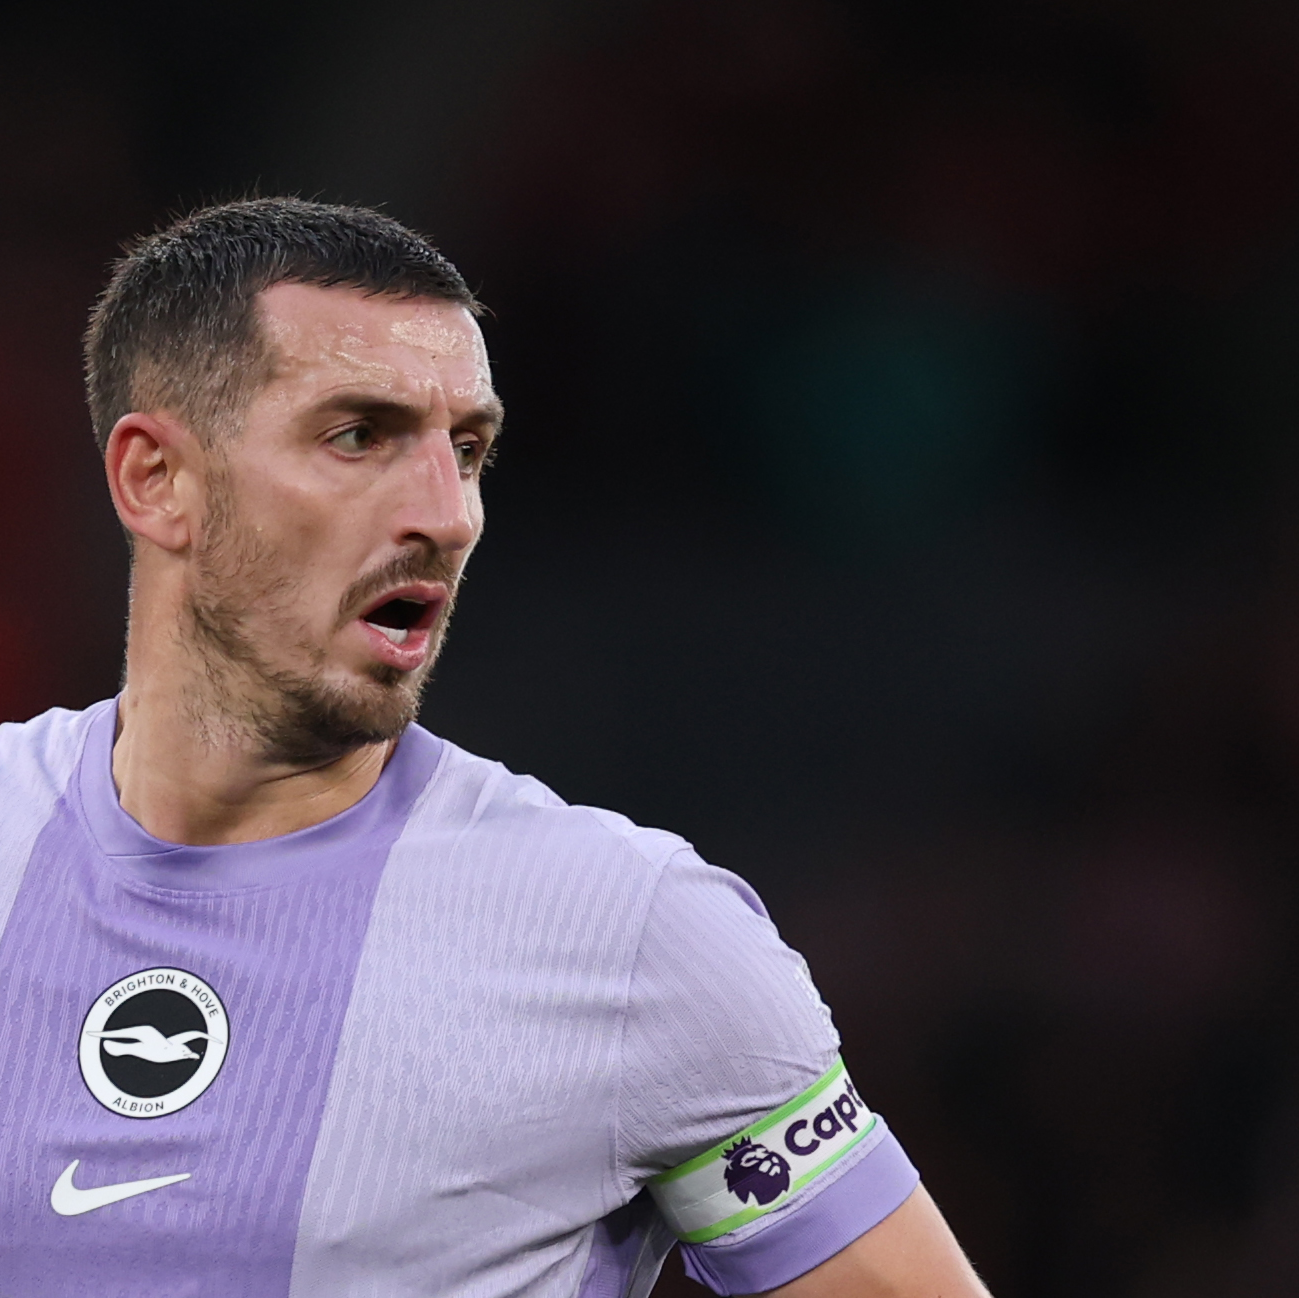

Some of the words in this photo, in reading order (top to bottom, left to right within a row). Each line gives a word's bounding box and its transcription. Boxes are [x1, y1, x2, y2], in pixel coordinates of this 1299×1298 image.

[104, 974, 176, 1007] BRIGHTON
[179, 978, 189, 989] &
[191, 984, 220, 1018] HOVE
[113, 1097, 165, 1113] ALBION
